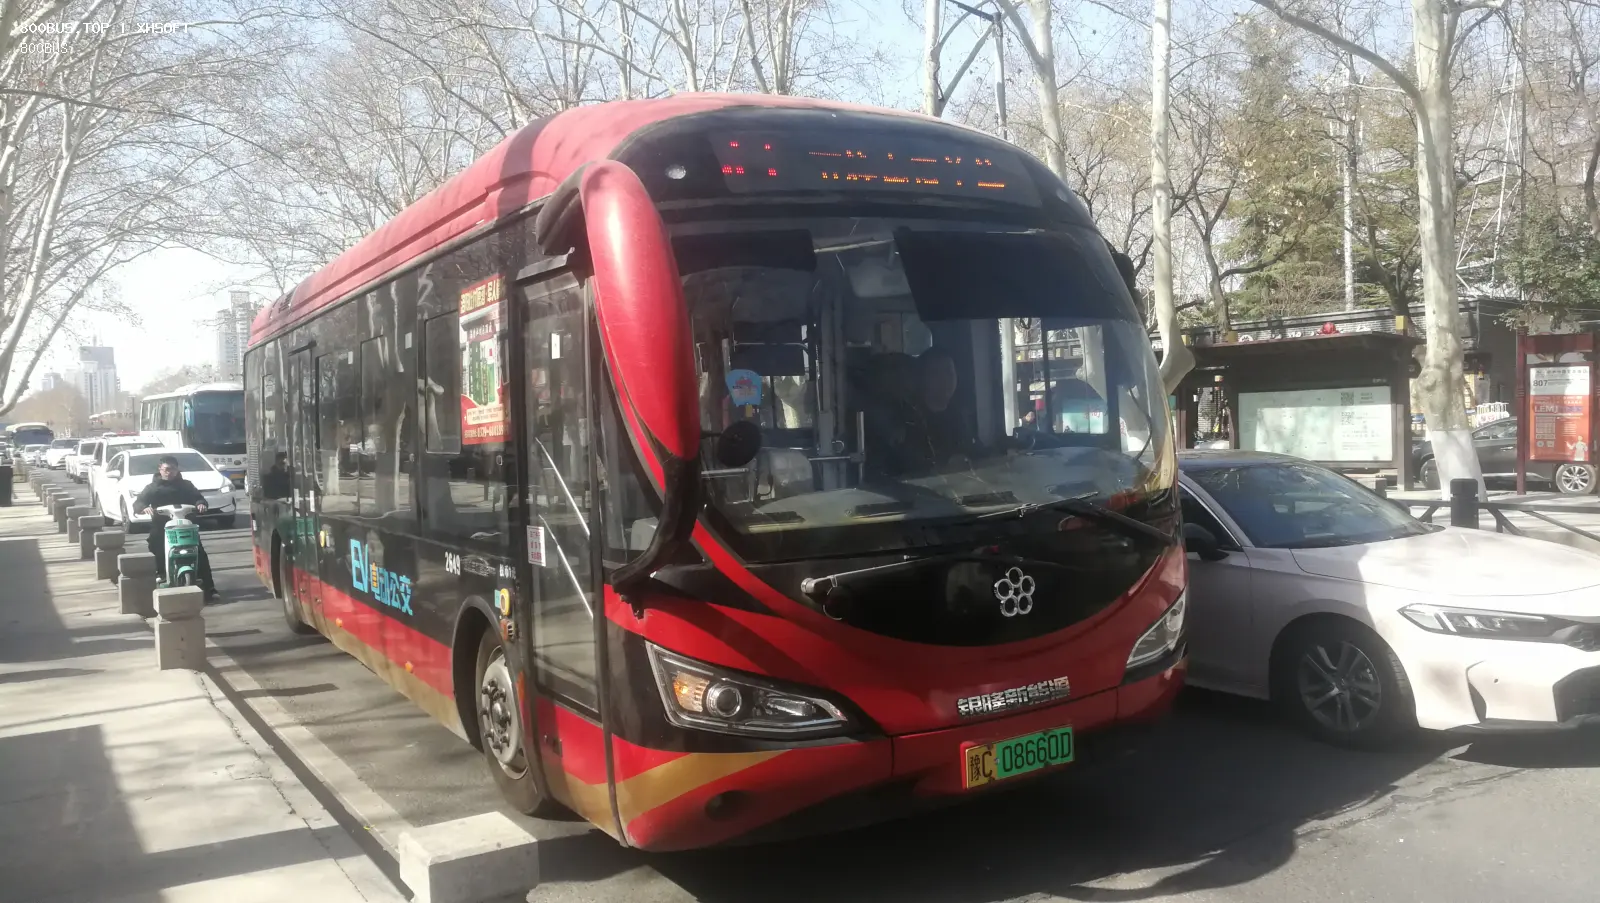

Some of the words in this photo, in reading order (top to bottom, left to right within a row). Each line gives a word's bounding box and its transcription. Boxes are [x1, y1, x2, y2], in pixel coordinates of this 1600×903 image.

[1533, 379, 1548, 387] 807
[350, 538, 369, 594] EV
[957, 675, 1070, 716] 银隆新能源
[1002, 731, 1071, 773] 08660D
